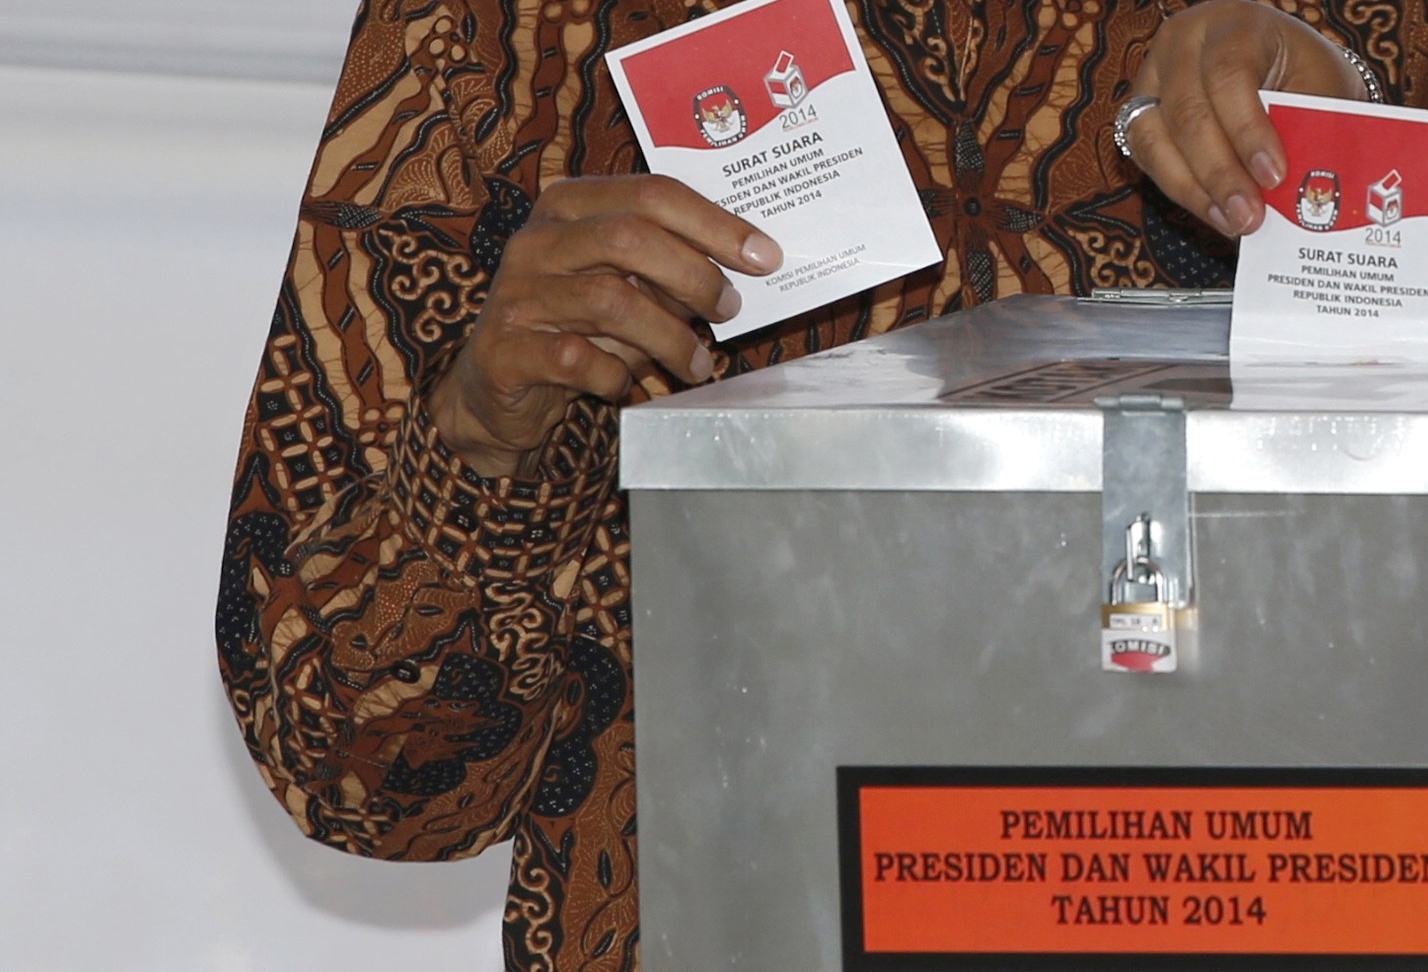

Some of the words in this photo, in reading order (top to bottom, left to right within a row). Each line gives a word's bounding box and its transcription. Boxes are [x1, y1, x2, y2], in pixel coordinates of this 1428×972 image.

[779, 103, 817, 129] 2014
[722, 150, 769, 178] SURAT
[772, 131, 824, 159] SUARA
[731, 162, 788, 189] PEMILIHAN
[790, 148, 825, 168] UMUM
[714, 189, 751, 207] SIDEN
[753, 179, 777, 195] DAN
[779, 167, 813, 185] WAKIL
[814, 146, 864, 173] PRESIDEN
[733, 191, 782, 216] REPUBLIK
[784, 169, 841, 197] INDONESIA
[760, 200, 796, 219] TAHUN
[798, 189, 823, 206] 2014
[1365, 227, 1401, 244] 2014
[765, 271, 794, 287] KOMISI
[794, 255, 838, 276] PEMILIHAN
[838, 244, 866, 260] UMUM
[1298, 247, 1343, 264] SURAT
[1347, 253, 1398, 269] SUARA
[1301, 265, 1357, 279] PEMILIHAN
[1359, 271, 1395, 282] UMUM
[779, 275, 817, 293] REPUBLIK
[817, 257, 861, 279] INDONESIA
[1267, 274, 1315, 288] PRESIDEN
[1318, 280, 1341, 290] DAN
[1343, 284, 1377, 293] WAKIL
[1293, 290, 1342, 303] REPUBLIK
[1344, 296, 1403, 307] INDONESIA
[1316, 304, 1351, 316] TAHUN
[1354, 308, 1380, 318] 2014
[1000, 810, 1193, 841] PEMILIHAN
[1205, 811, 1314, 840] UMUM
[874, 852, 1049, 883] PRESIDEN
[1060, 853, 1131, 883] DAN
[1142, 853, 1257, 883] WAKIL
[1051, 895, 1170, 925] TAHUN
[1183, 896, 1267, 926] 2014
